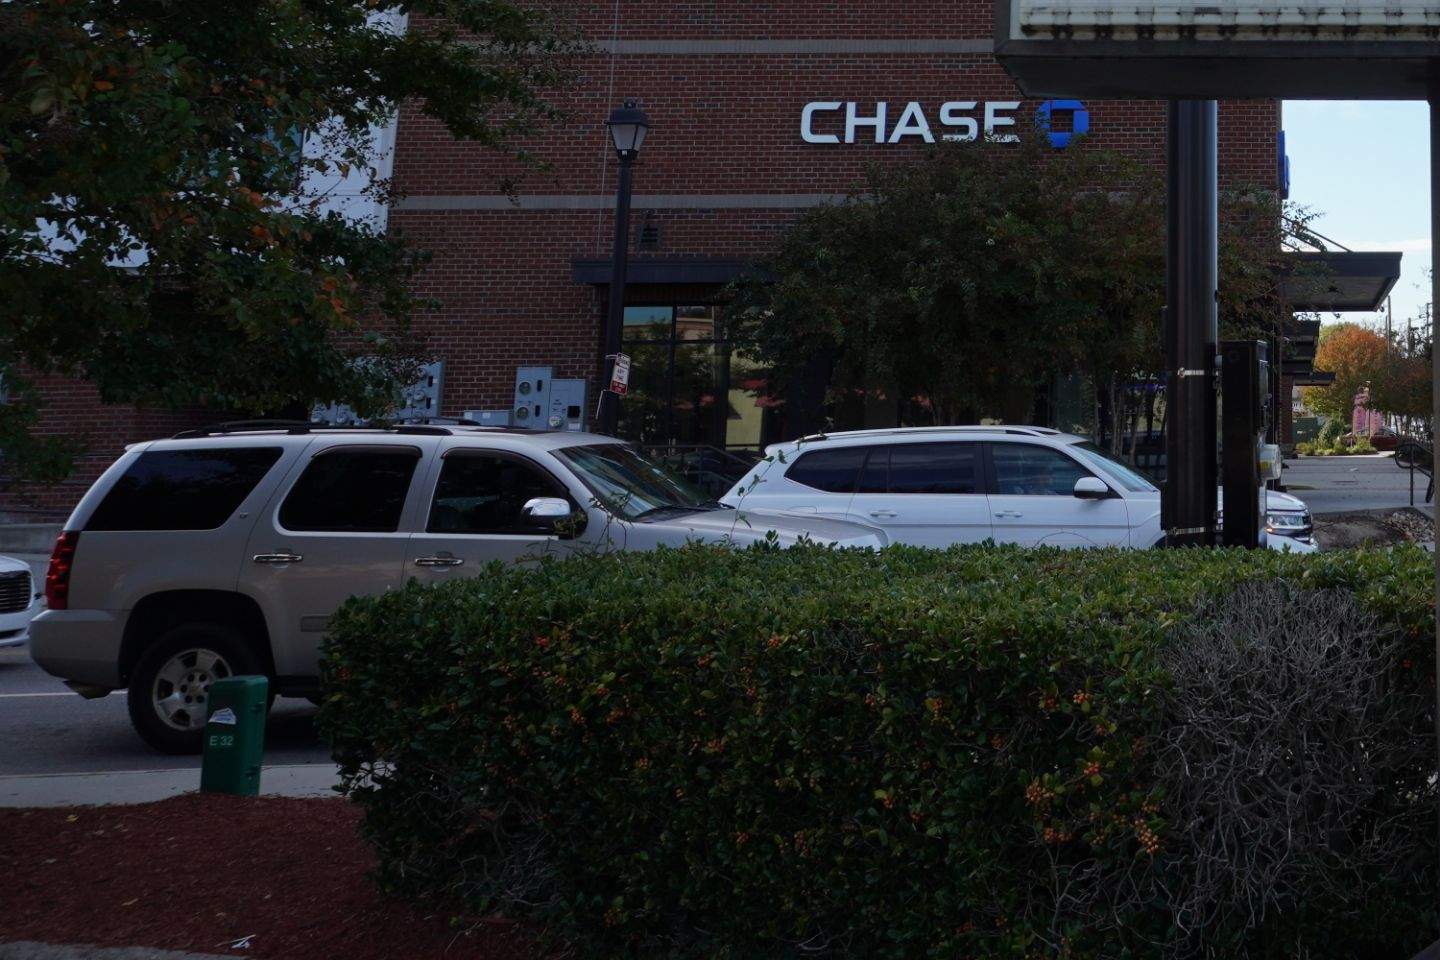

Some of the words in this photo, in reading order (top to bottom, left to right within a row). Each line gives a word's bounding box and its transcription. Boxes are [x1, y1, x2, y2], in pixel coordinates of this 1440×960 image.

[800, 101, 1021, 144] CHASE
[209, 735, 218, 746] E
[219, 735, 234, 746] 32
